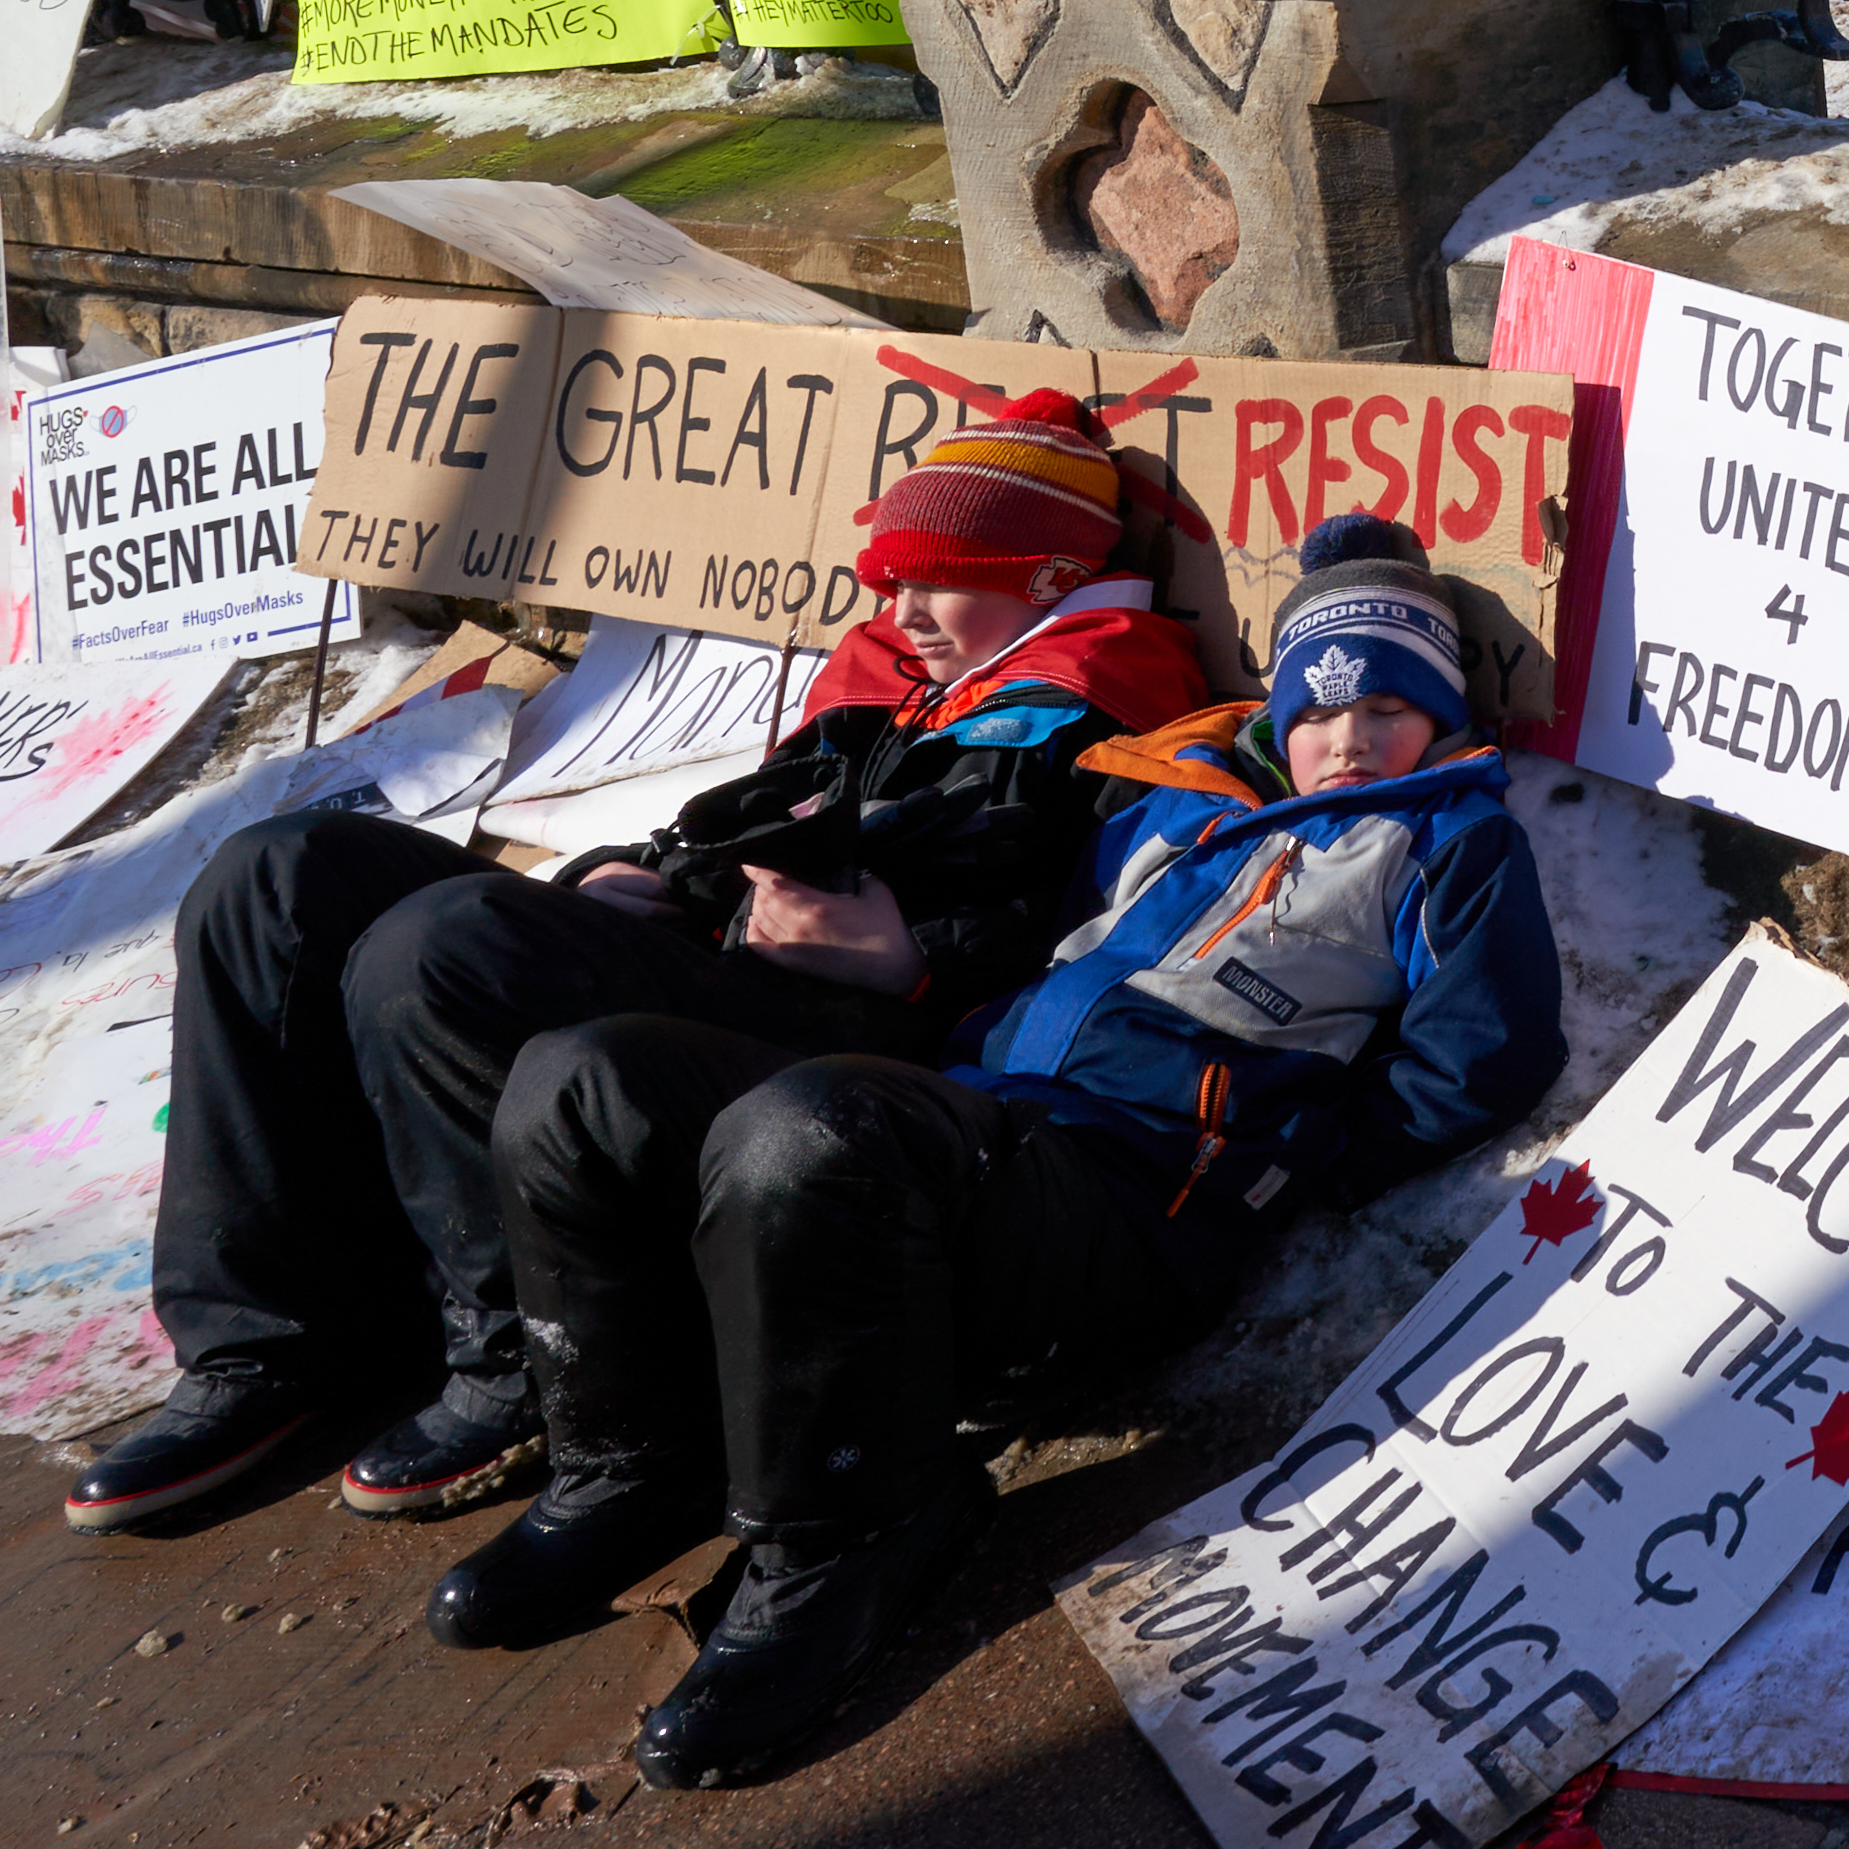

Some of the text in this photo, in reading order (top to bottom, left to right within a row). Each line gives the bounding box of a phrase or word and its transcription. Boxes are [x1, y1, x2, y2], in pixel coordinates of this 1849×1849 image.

[300, 0, 619, 75] #ENDTHEMANDATES
[39, 407, 83, 436] HUGS
[46, 426, 77, 449] over
[354, 332, 519, 469] THE
[556, 349, 833, 497] GREAT
[1226, 395, 1574, 565] RESIST
[49, 421, 320, 535] WE ARE ALL
[316, 509, 672, 599] THEY WILL OWN
[72, 590, 304, 652] #FactsOverFear #HugsOverMasks
[1287, 601, 1409, 642] TORONTO
[1764, 583, 1809, 645] 4
[1221, 965, 1294, 1020] MONSTER
[1570, 1182, 1673, 1296] TO
[1374, 1270, 1671, 1553] LOVE
[1240, 1420, 1619, 1812] CHANGE
[1088, 1533, 1461, 1849] MOVEMENT
